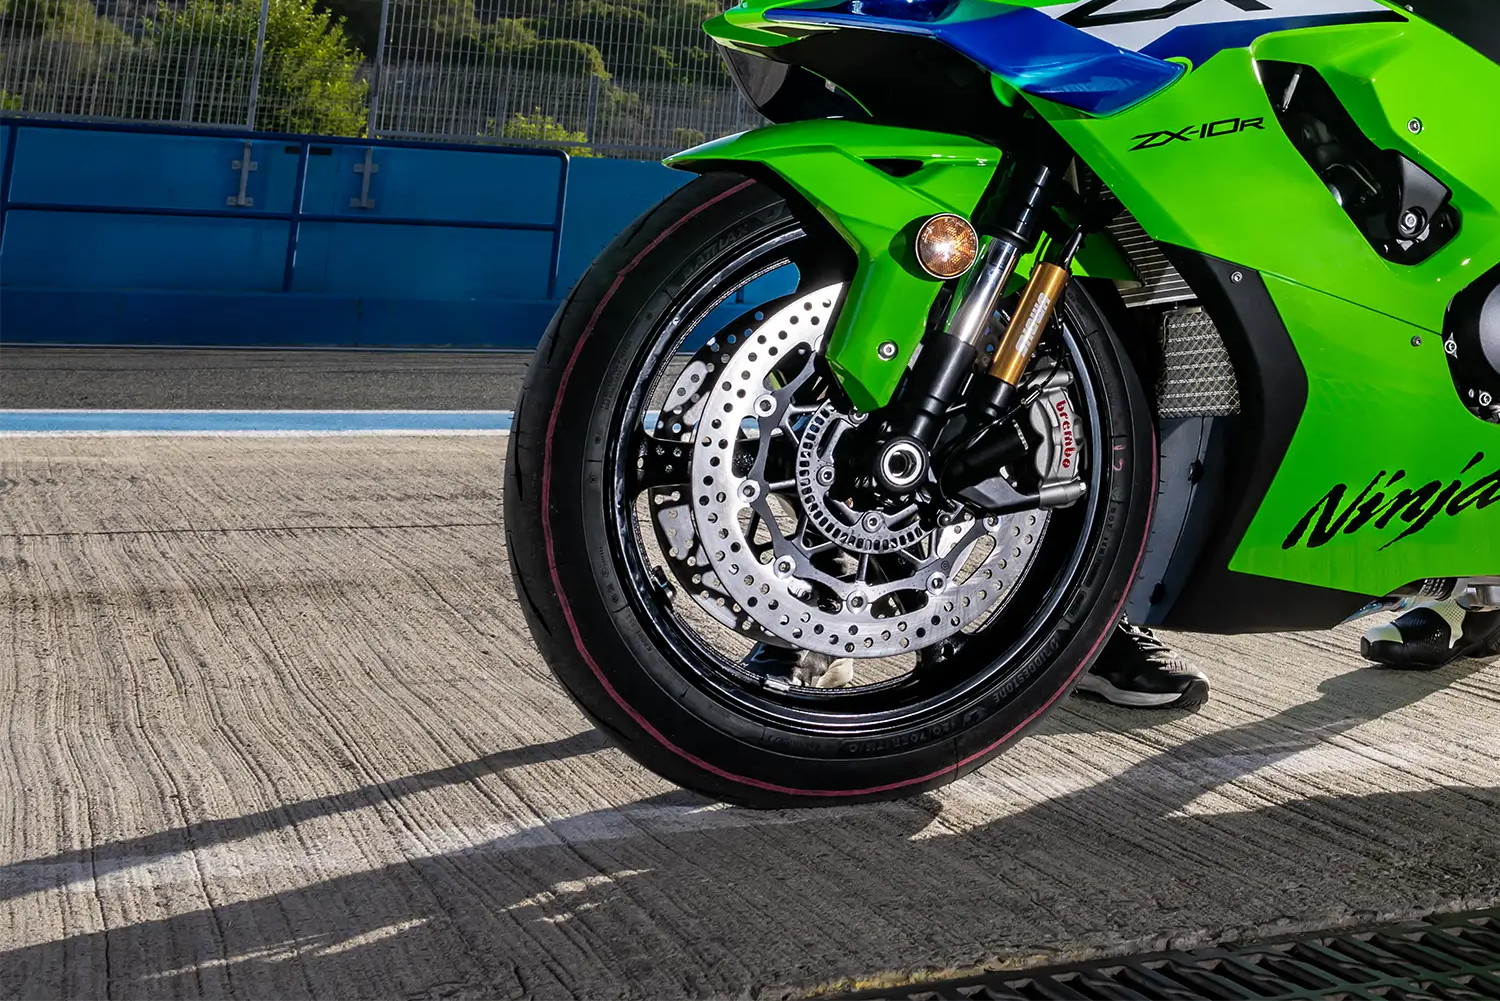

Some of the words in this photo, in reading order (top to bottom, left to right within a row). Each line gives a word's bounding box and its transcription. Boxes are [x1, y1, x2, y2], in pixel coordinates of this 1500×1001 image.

[1127, 117, 1265, 152] ZX-10R
[1015, 292, 1051, 358] SHOWA
[1055, 399, 1076, 469] brembo
[992, 637, 1060, 704] BRIDGESTONE
